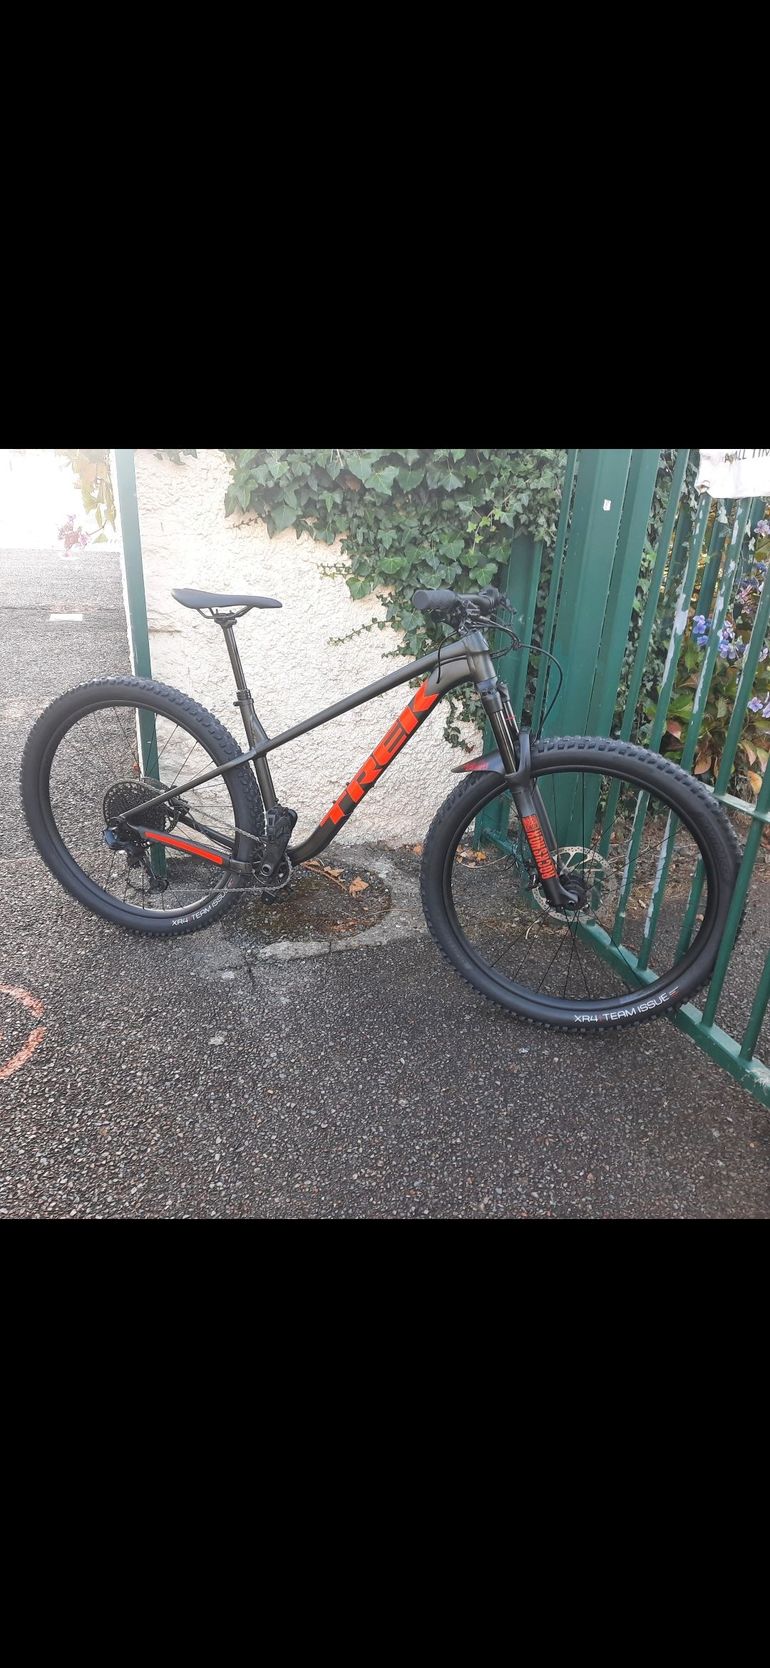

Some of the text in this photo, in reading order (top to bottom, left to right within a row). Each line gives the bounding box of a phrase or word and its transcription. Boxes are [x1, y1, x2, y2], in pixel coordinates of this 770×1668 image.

[320, 679, 439, 827] TREK
[191, 904, 212, 921] TEAM
[574, 992, 671, 1023] XR4 TEAM ISSUE
